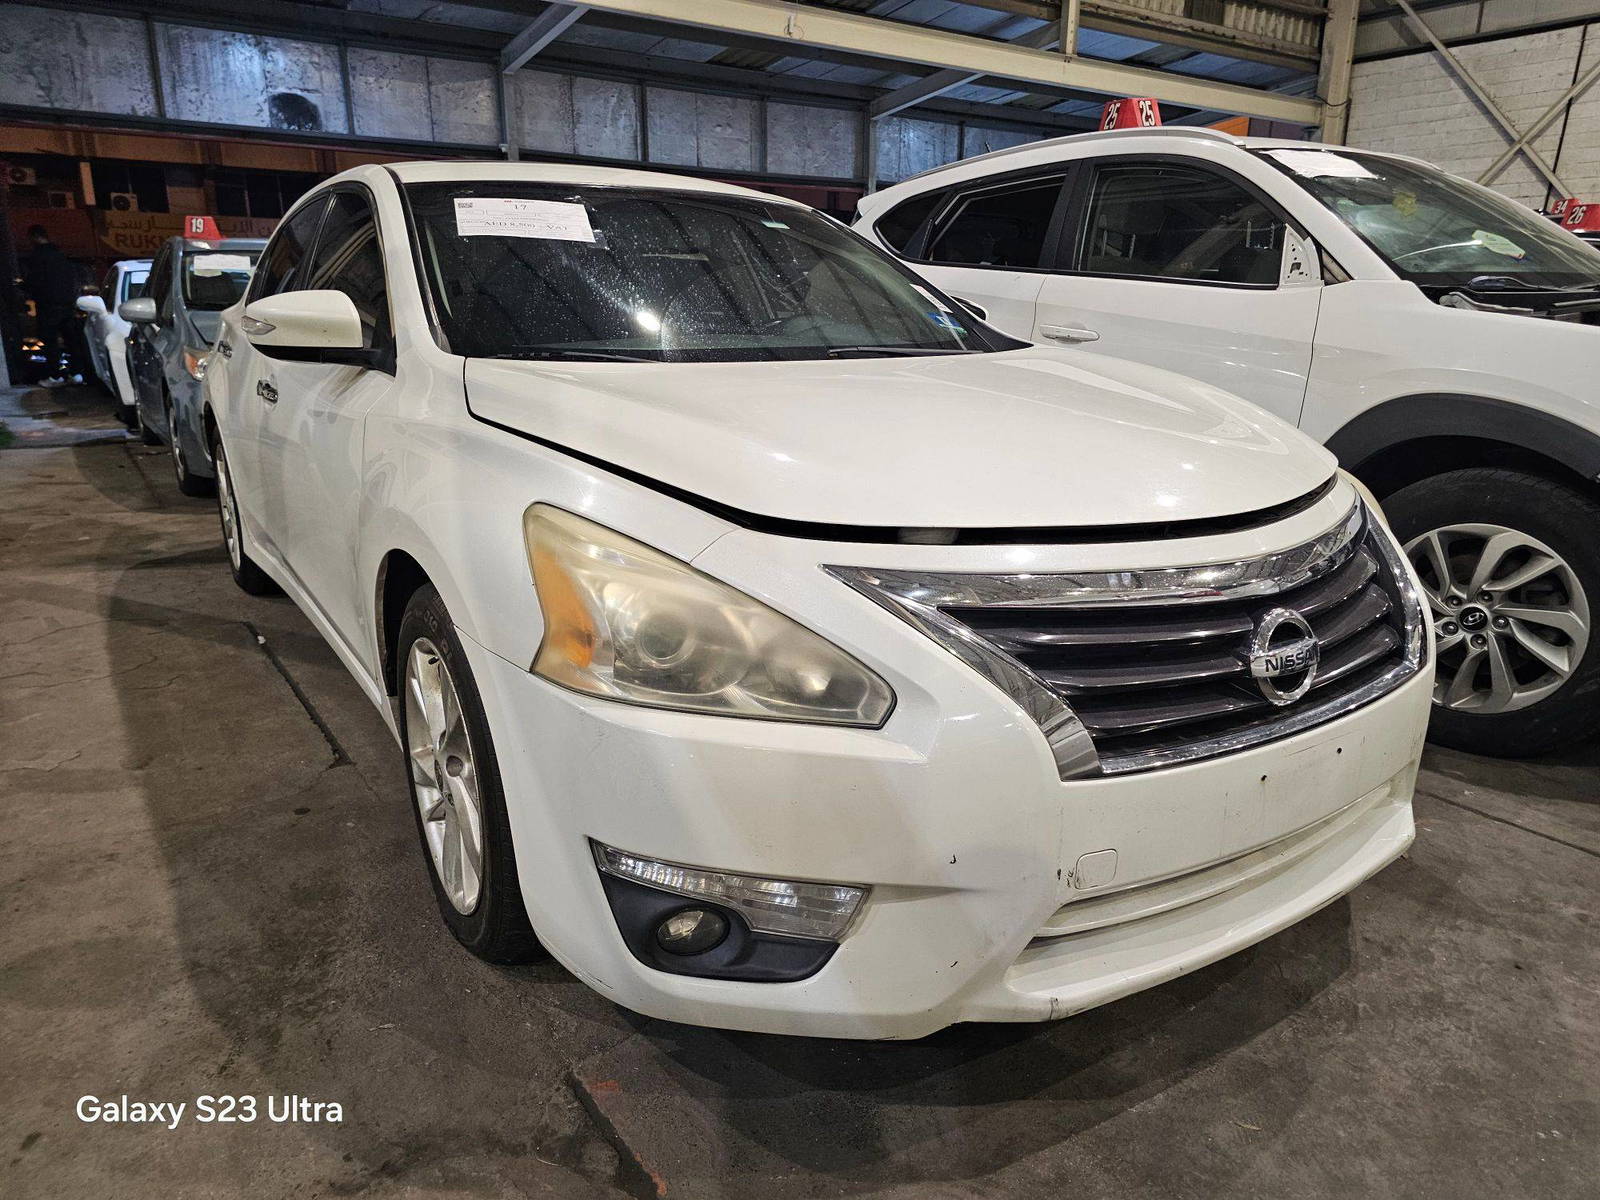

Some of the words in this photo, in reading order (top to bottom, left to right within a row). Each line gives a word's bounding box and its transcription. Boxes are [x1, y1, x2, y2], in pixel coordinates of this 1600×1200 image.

[1103, 102, 1121, 130] 25
[1139, 100, 1156, 127] 25
[1554, 200, 1569, 214] 34
[1566, 205, 1587, 225] 26
[191, 218, 204, 233] 19
